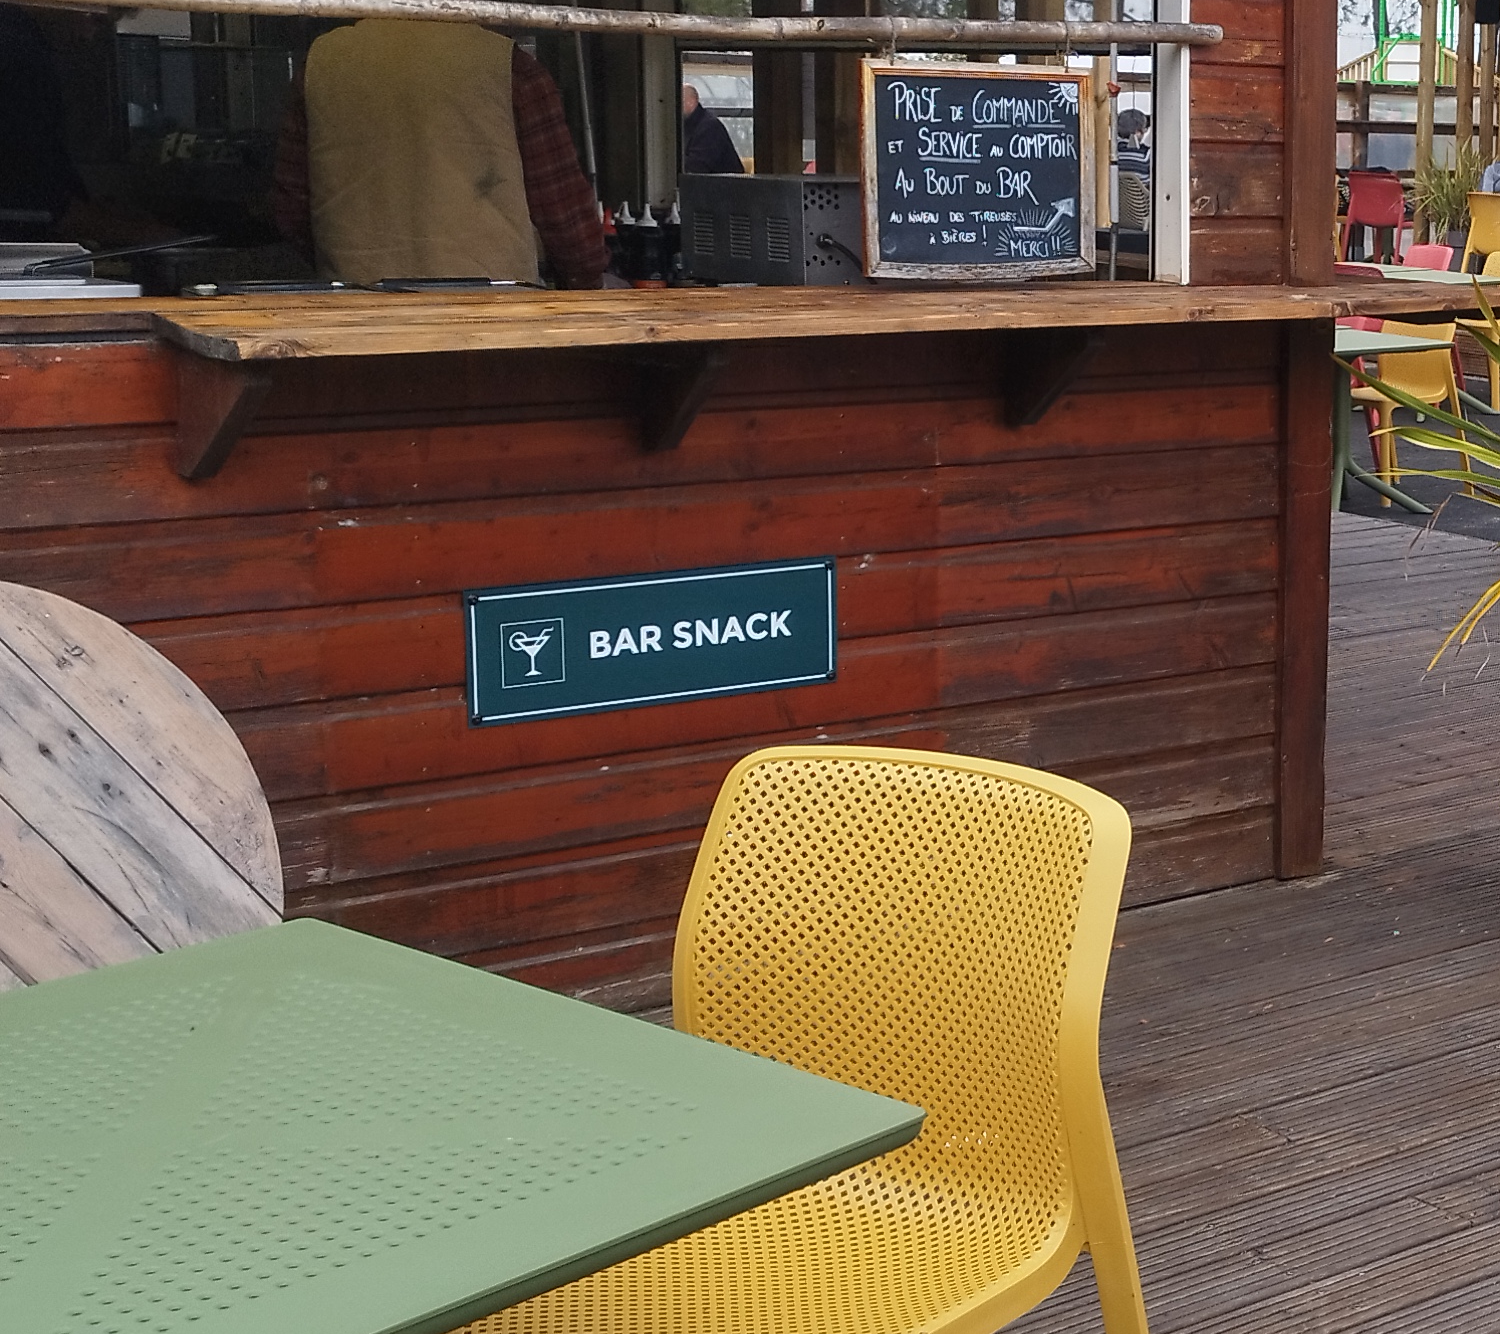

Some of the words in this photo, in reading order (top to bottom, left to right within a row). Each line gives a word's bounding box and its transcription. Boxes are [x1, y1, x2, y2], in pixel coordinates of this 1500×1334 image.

[949, 105, 964, 122] DE
[972, 89, 1062, 126] COMMANDE
[888, 139, 904, 154] ET
[990, 144, 1004, 158] AU
[924, 167, 970, 197] BOUT
[975, 180, 991, 194] DU
[996, 166, 1039, 205] BAR
[890, 210, 903, 224] AU
[949, 210, 965, 224] DES
[589, 624, 663, 659] BAR
[672, 610, 792, 649] SNACK
